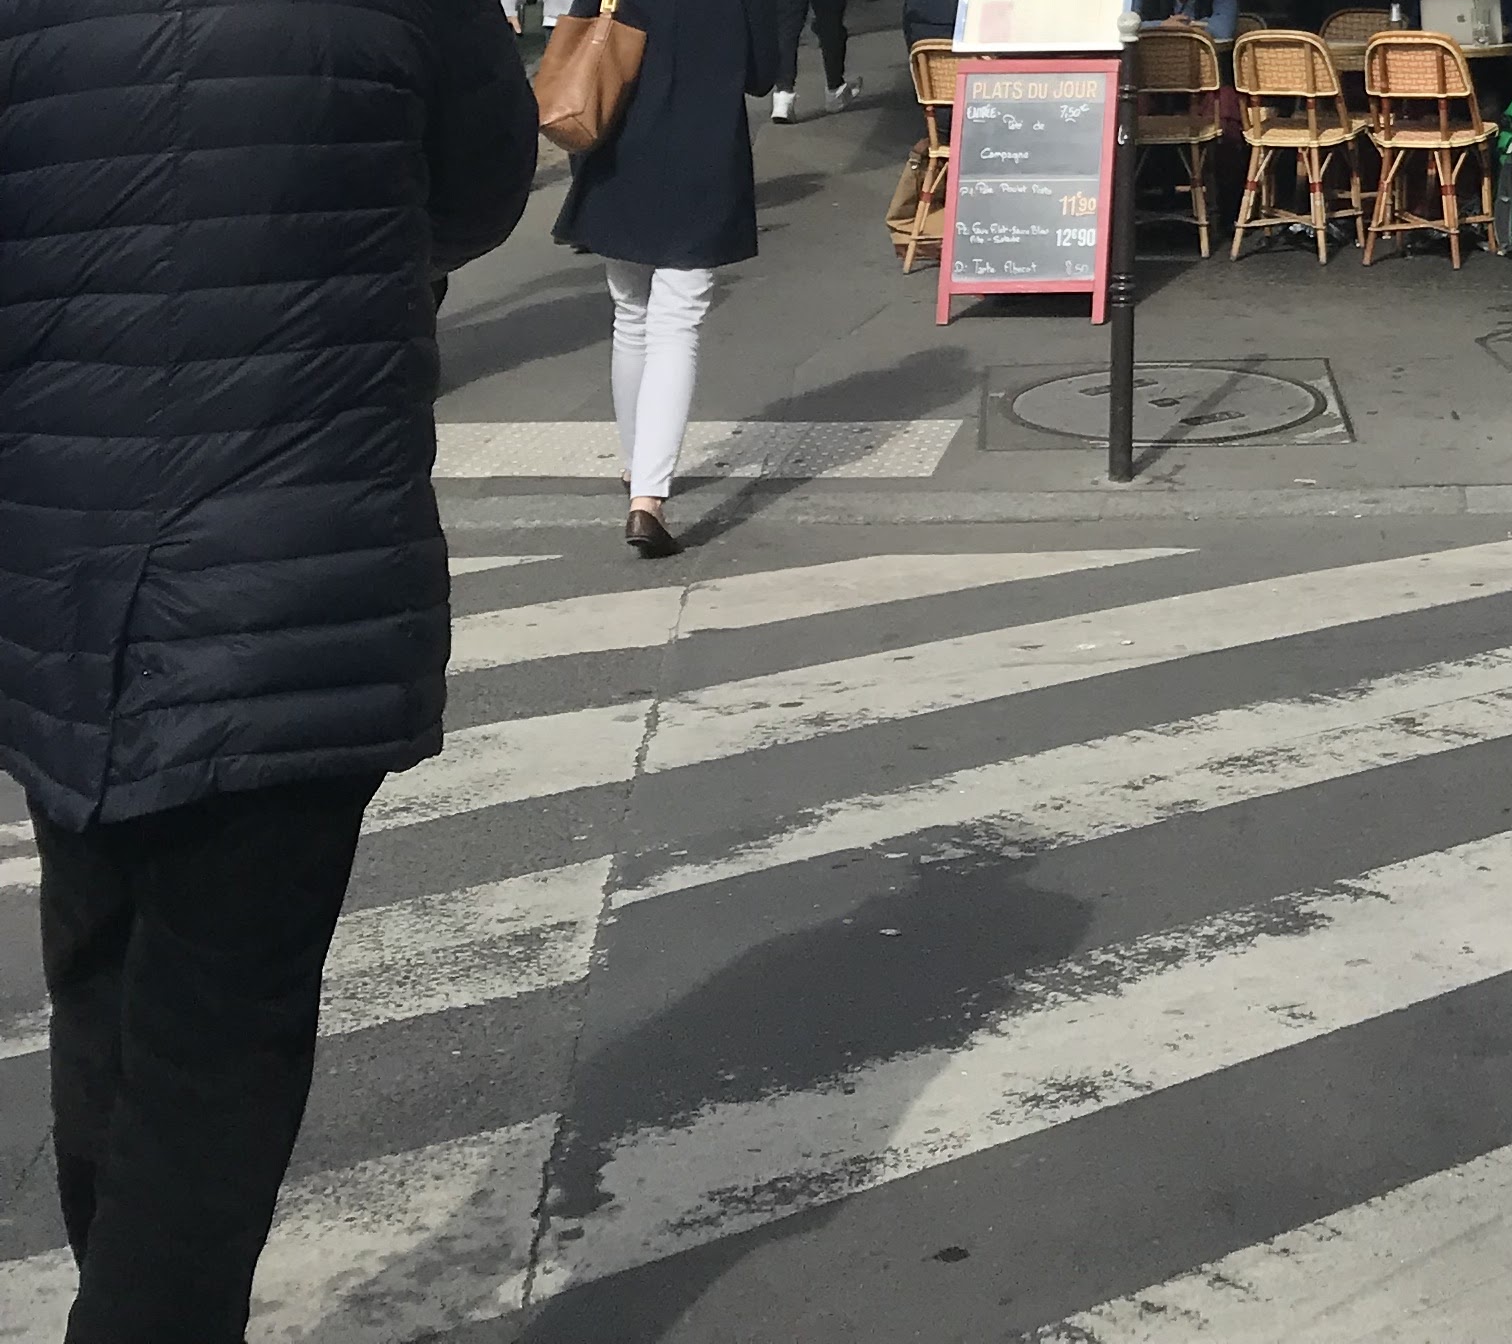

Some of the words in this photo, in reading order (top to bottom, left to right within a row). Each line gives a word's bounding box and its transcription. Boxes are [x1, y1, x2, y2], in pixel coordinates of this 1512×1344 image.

[972, 81, 1023, 100] PLATS
[1028, 82, 1048, 99] DU
[1053, 80, 1098, 99] JOUR
[1032, 120, 1045, 131] de
